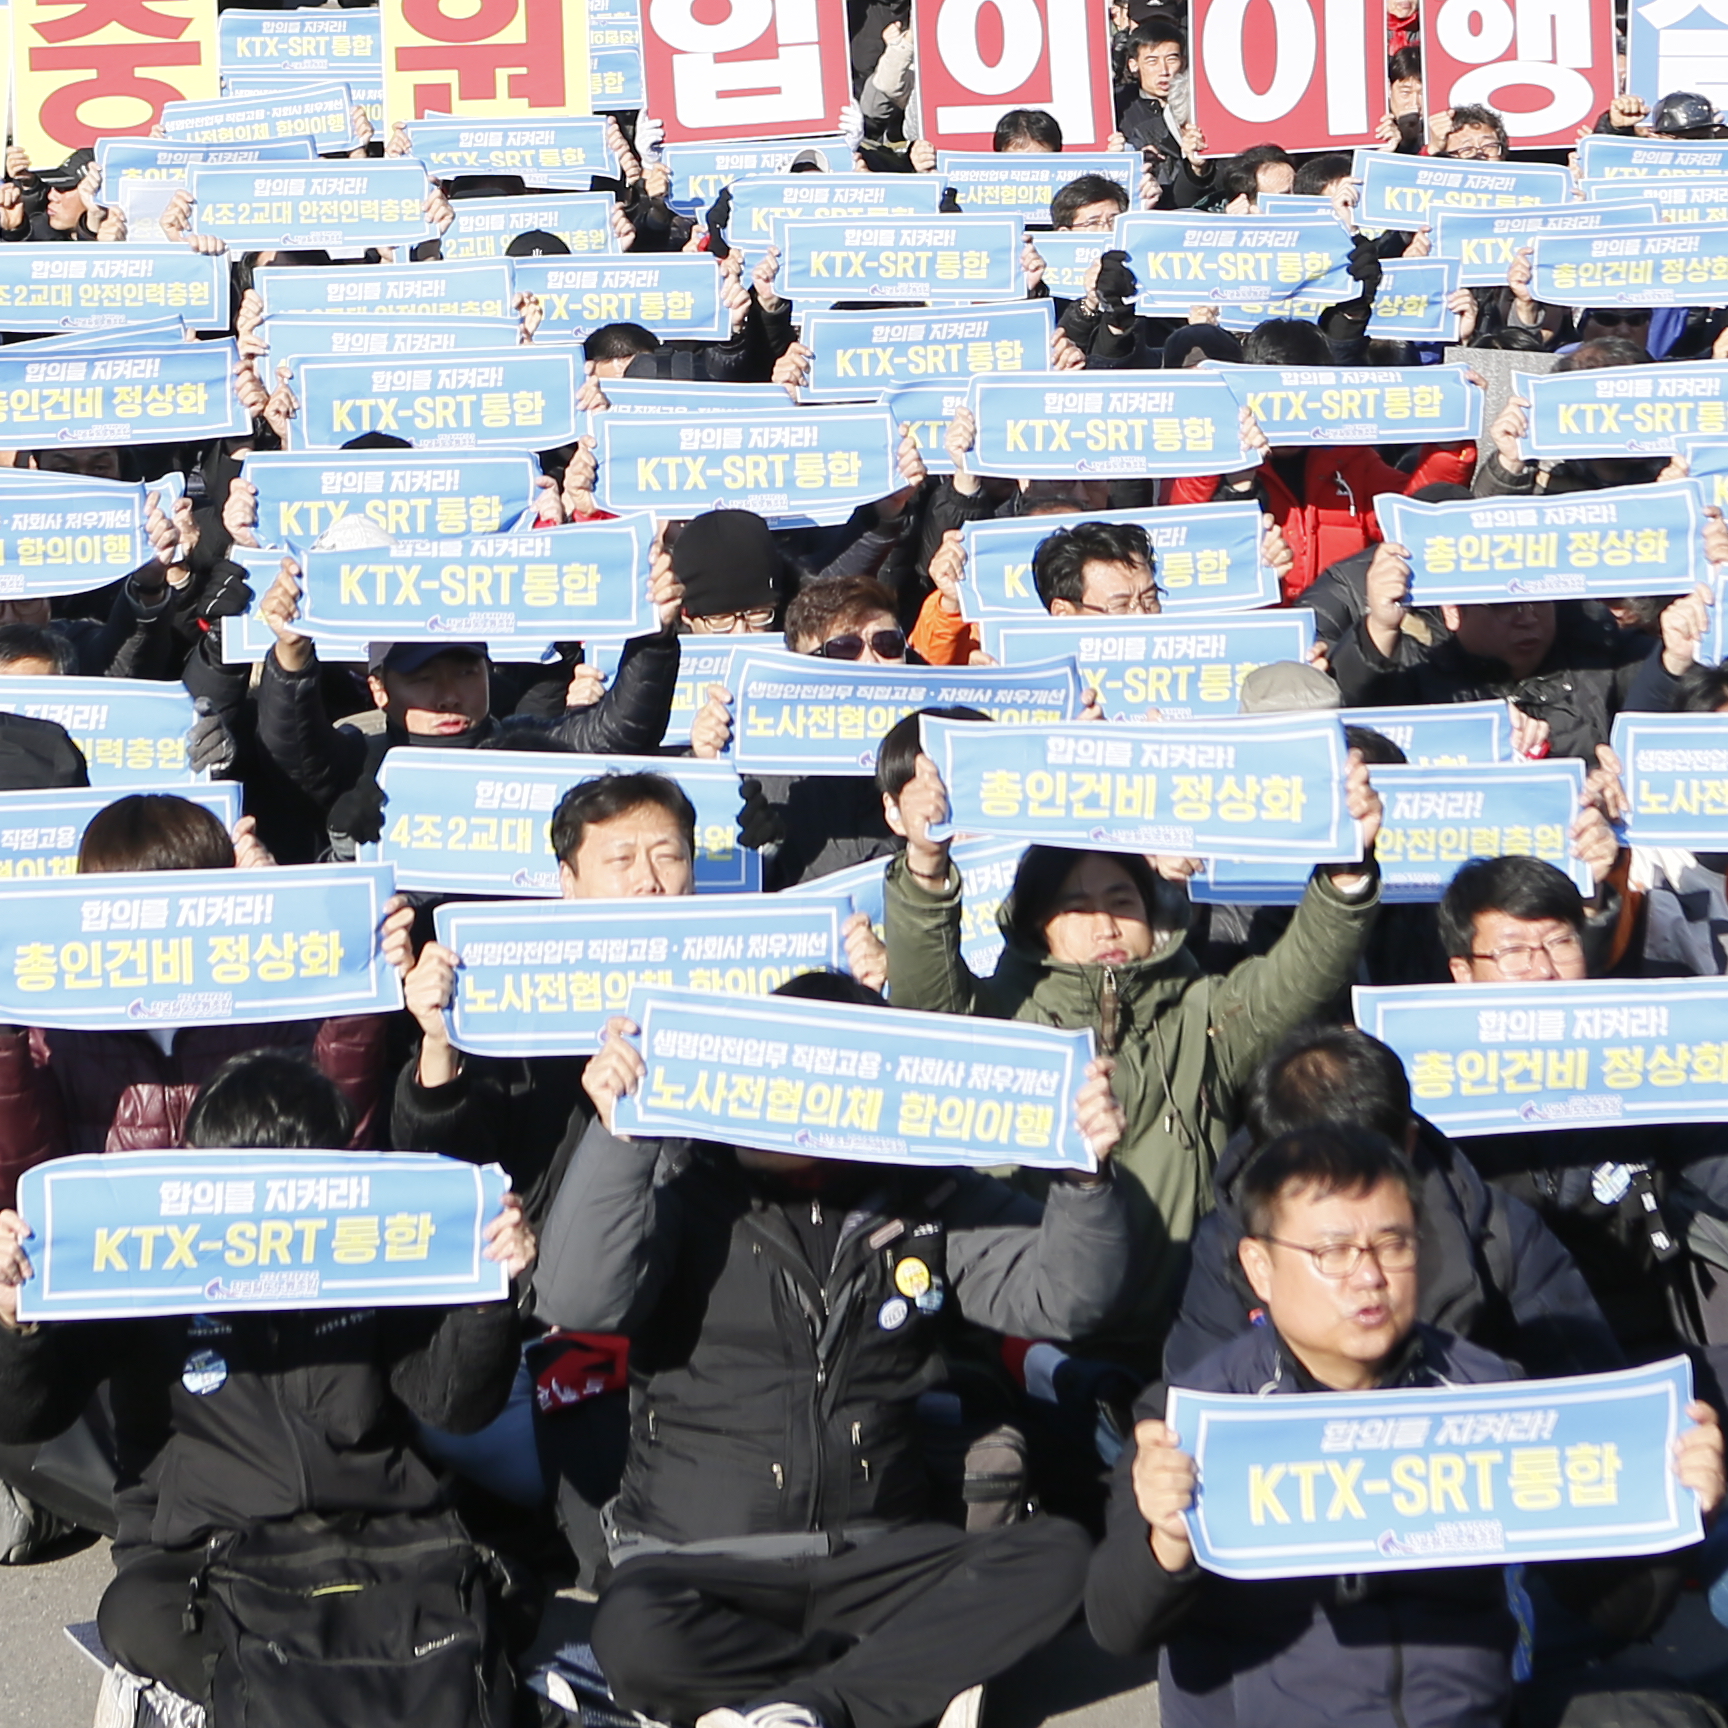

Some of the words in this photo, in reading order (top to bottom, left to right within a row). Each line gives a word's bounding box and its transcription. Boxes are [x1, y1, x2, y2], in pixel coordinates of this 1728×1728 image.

[1046, 735, 1133, 770] 합의를
[978, 765, 1160, 825] 총인건비
[1170, 769, 1308, 829] 정상화
[80, 896, 177, 935] 합의를
[12, 931, 194, 993] 총인건비
[205, 926, 346, 985] 정상화
[1476, 1007, 1564, 1045] 합의를
[1410, 1042, 1589, 1100] 총인건비
